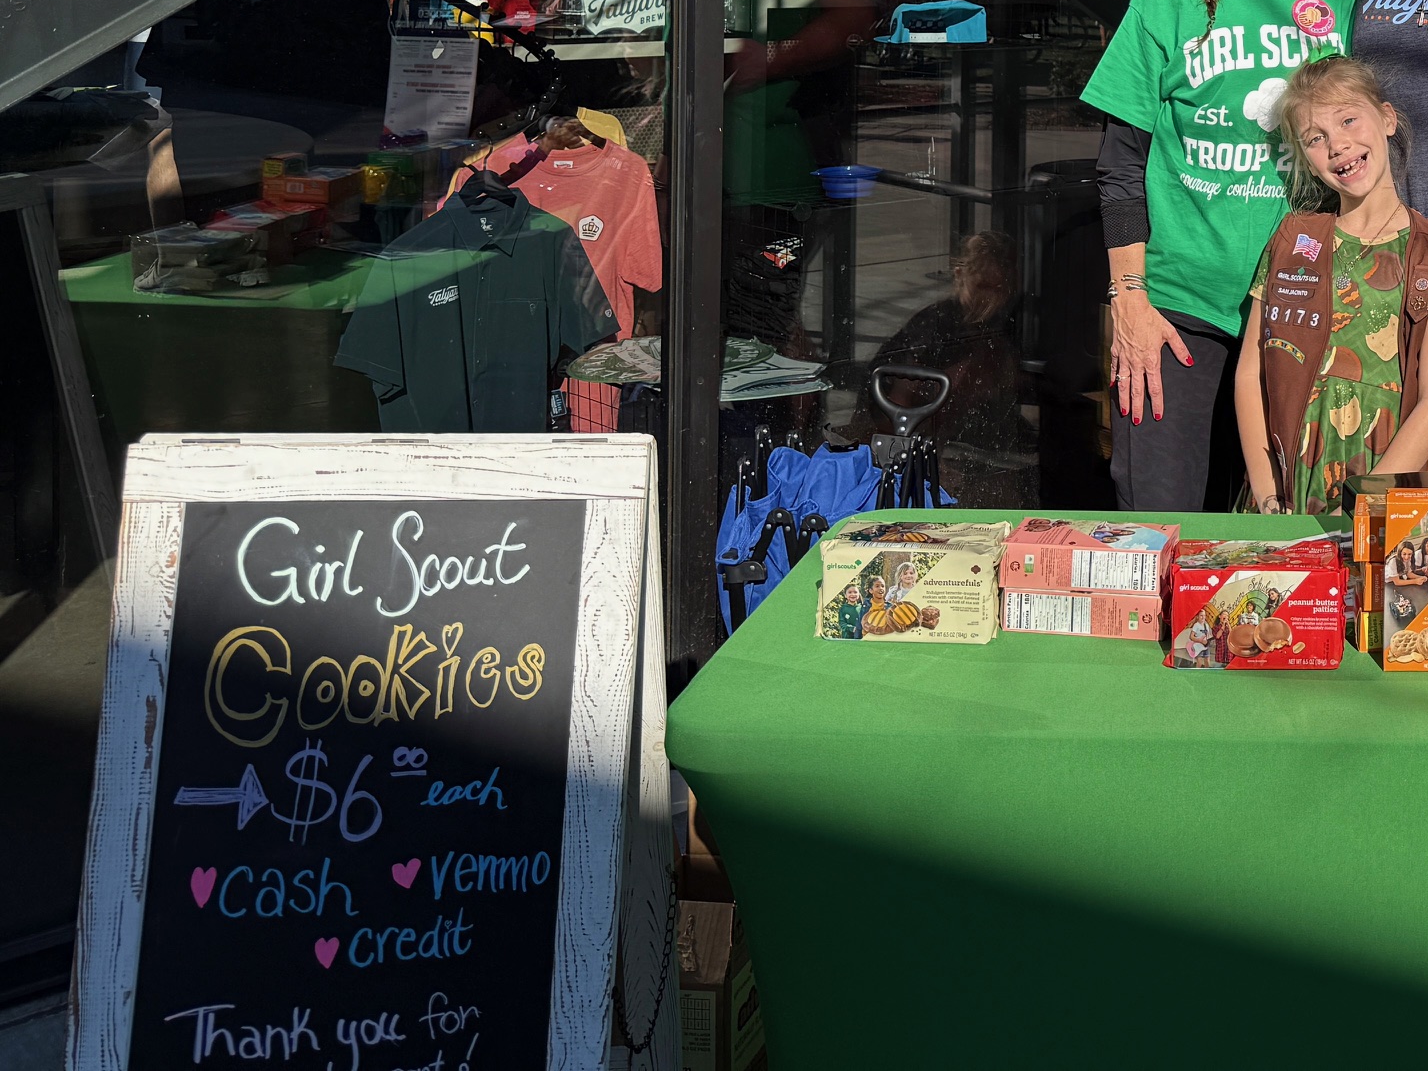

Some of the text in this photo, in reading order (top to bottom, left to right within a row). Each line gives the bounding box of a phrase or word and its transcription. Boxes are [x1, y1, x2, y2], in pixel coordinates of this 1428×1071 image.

[640, 12, 666, 25] BREW
[1183, 25, 1255, 89] GIRL
[1194, 104, 1233, 127] Est.
[1183, 136, 1270, 172] TROOP
[1180, 172, 1288, 204] courage confidence
[237, 510, 530, 618] Girl Scout
[827, 562, 837, 571] girl
[923, 579, 980, 588] adventurefuls
[204, 622, 544, 748] Cookies
[420, 766, 508, 810] each
[218, 857, 358, 918] cash
[430, 850, 550, 900] venmo
[348, 918, 474, 968] credit
[164, 992, 482, 1070] Thank you for
